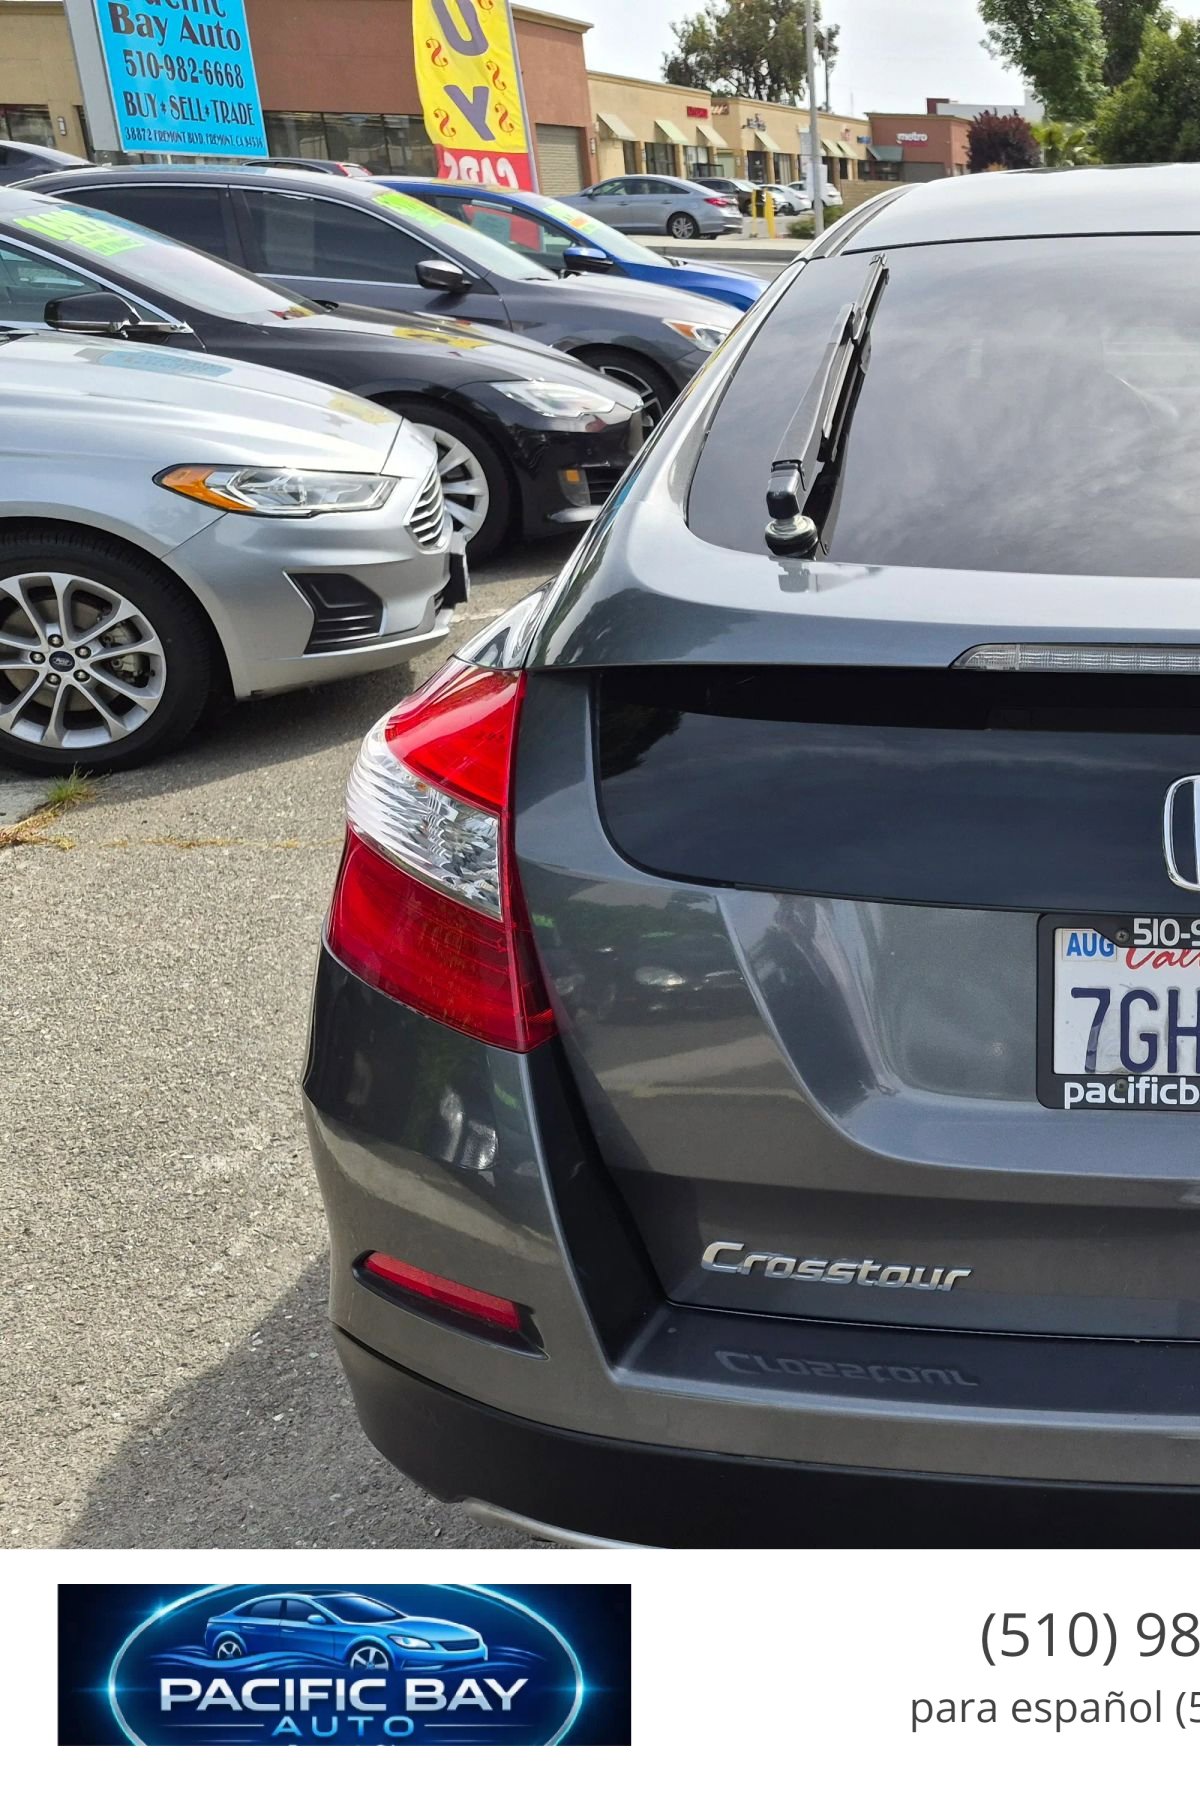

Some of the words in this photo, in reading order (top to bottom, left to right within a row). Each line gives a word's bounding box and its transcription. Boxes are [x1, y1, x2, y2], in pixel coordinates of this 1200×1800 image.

[108, 2, 168, 46] Bay
[180, 15, 241, 51] Auto
[123, 49, 244, 88] 510-982-6668
[123, 91, 157, 118] BUY
[170, 95, 206, 122] SELL
[210, 100, 255, 126] TRADE
[125, 127, 153, 140] 38872
[154, 130, 185, 143] FREMONT
[1066, 933, 1114, 957] AUG
[701, 1241, 972, 1292] Crosstour
